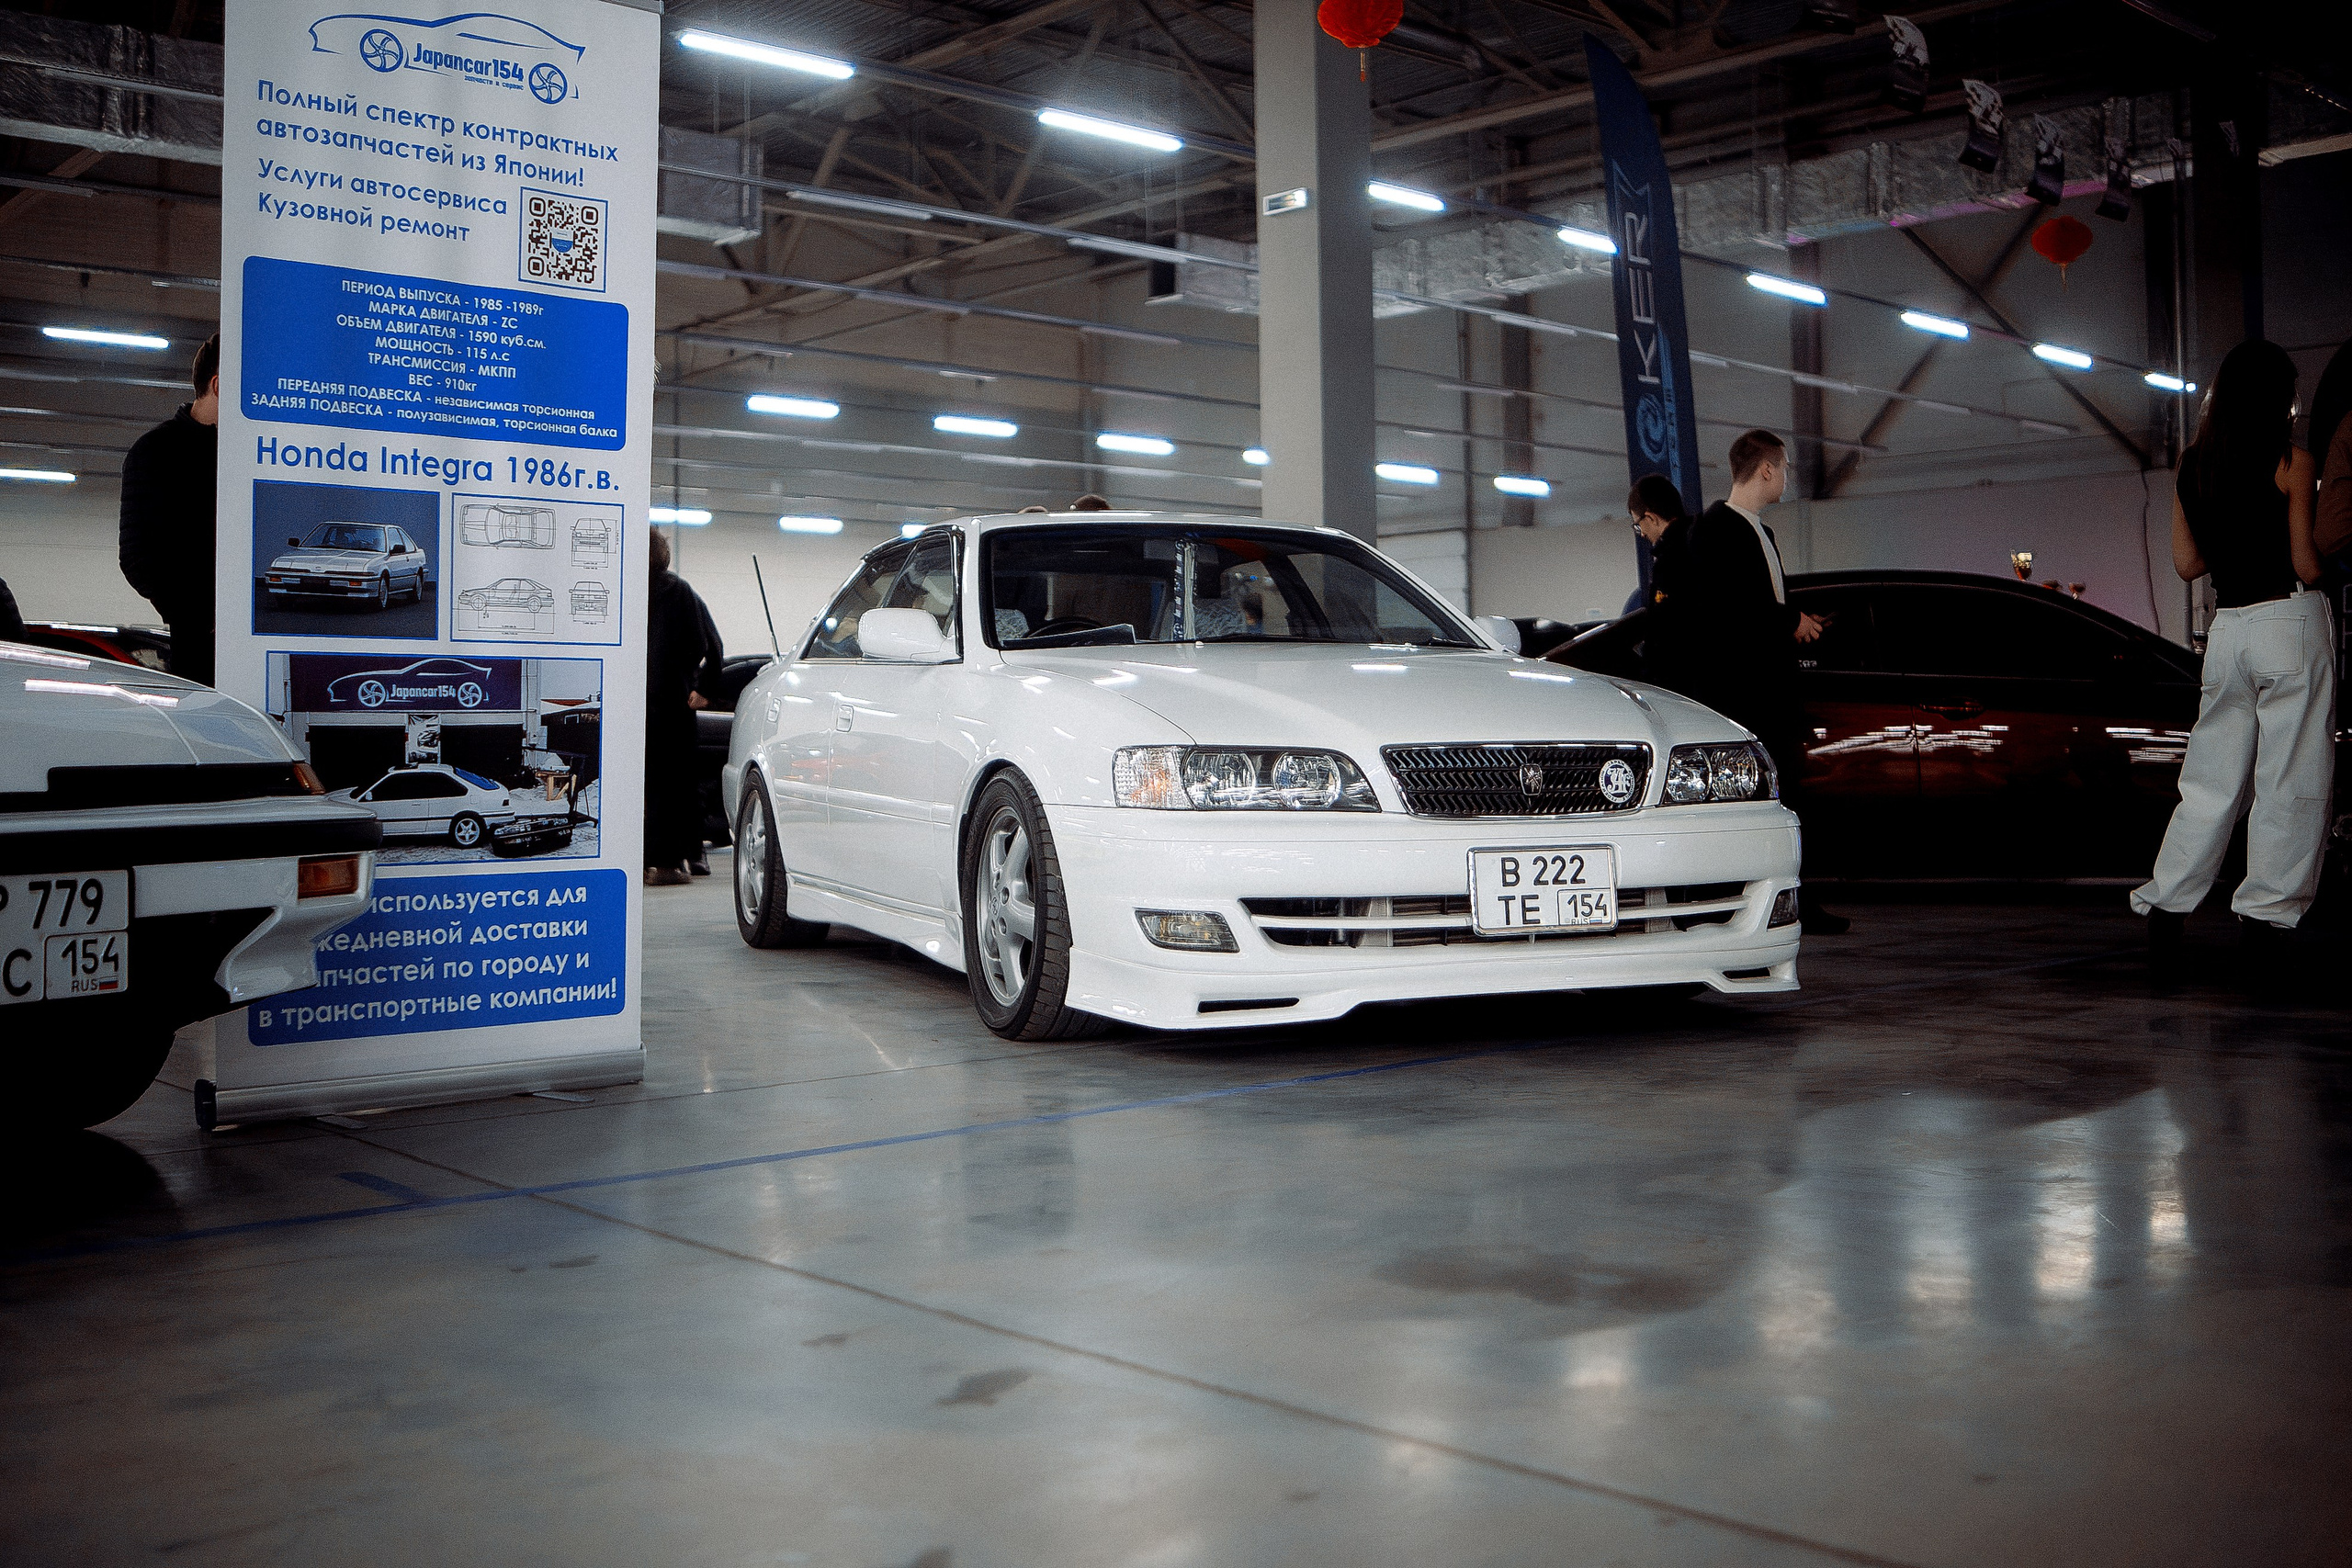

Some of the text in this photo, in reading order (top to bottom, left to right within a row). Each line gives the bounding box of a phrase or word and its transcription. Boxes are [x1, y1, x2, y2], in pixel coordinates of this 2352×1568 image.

[413, 42, 525, 84] Japancar154
[258, 80, 617, 161] Полный спектр контрактных
[256, 119, 583, 186] автозапчастей из Японии!
[258, 158, 507, 214] Услуги автосервиса
[259, 192, 469, 240] Кузовной ремонт
[342, 279, 396, 299] ПЕРИОД
[400, 288, 460, 306] ВЫПУСКА
[474, 298, 503, 310] 1985
[368, 301, 416, 317] МАРКА
[420, 308, 488, 326] ДВИГАТЕЛЯ
[336, 314, 382, 330] ОБЪЕМ
[385, 321, 456, 338] ДВИГАТЕЛЯ
[469, 331, 497, 344] 1590
[501, 335, 546, 349] куб.см.
[368, 352, 467, 374] ТРАНСМИССИЯ
[478, 365, 515, 378] МКПП
[375, 336, 454, 355] МОЩНОСТЬ
[467, 346, 487, 359] 115
[491, 352, 510, 361] л.с
[278, 378, 345, 395] ПЕРЕДНЯЯ
[349, 385, 422, 402] ПОДВЕСКА
[435, 396, 520, 412] независимая
[522, 402, 595, 420] торсионная
[409, 374, 433, 387] ВЕС
[445, 378, 477, 391] 910кг
[252, 393, 306, 409] ЗАДНЯЯ
[311, 399, 383, 416] ПОДВЕСКА
[397, 410, 499, 427] полузависимая,
[503, 419, 576, 434] торсионная
[580, 424, 617, 437] балка
[257, 436, 619, 491] Honda Integra 1986г.в.
[390, 682, 458, 700] Japancar154
[1532, 854, 1586, 886] 222
[28, 878, 104, 929] 779
[546, 886, 586, 907] для
[1566, 892, 1608, 919] 154
[469, 919, 587, 944] доставки
[61, 936, 120, 977] 154
[444, 961, 473, 978] по
[482, 953, 569, 979] городу
[576, 953, 589, 968] и
[71, 979, 99, 993] RUS
[259, 977, 616, 1029] в транспортные компании!
